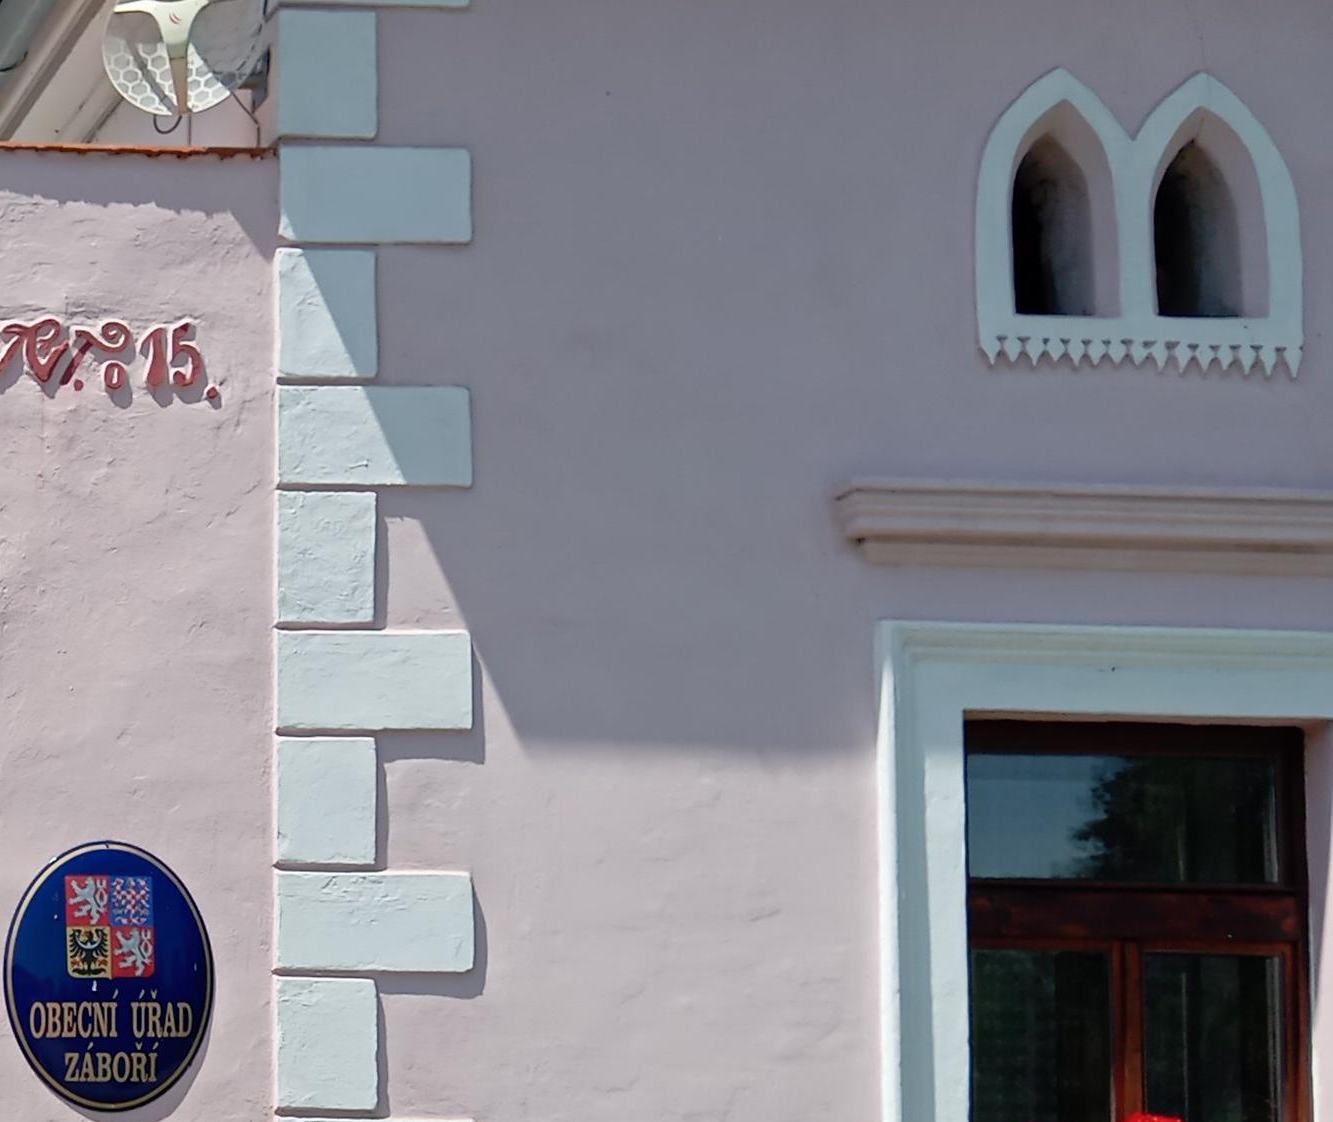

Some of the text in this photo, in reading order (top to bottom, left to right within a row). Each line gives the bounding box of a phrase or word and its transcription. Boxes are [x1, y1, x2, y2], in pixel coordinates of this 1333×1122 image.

[29, 988, 194, 1039] OBECNÍ ÚŘAD
[64, 1041, 160, 1083] ZÁBOŘÍ
